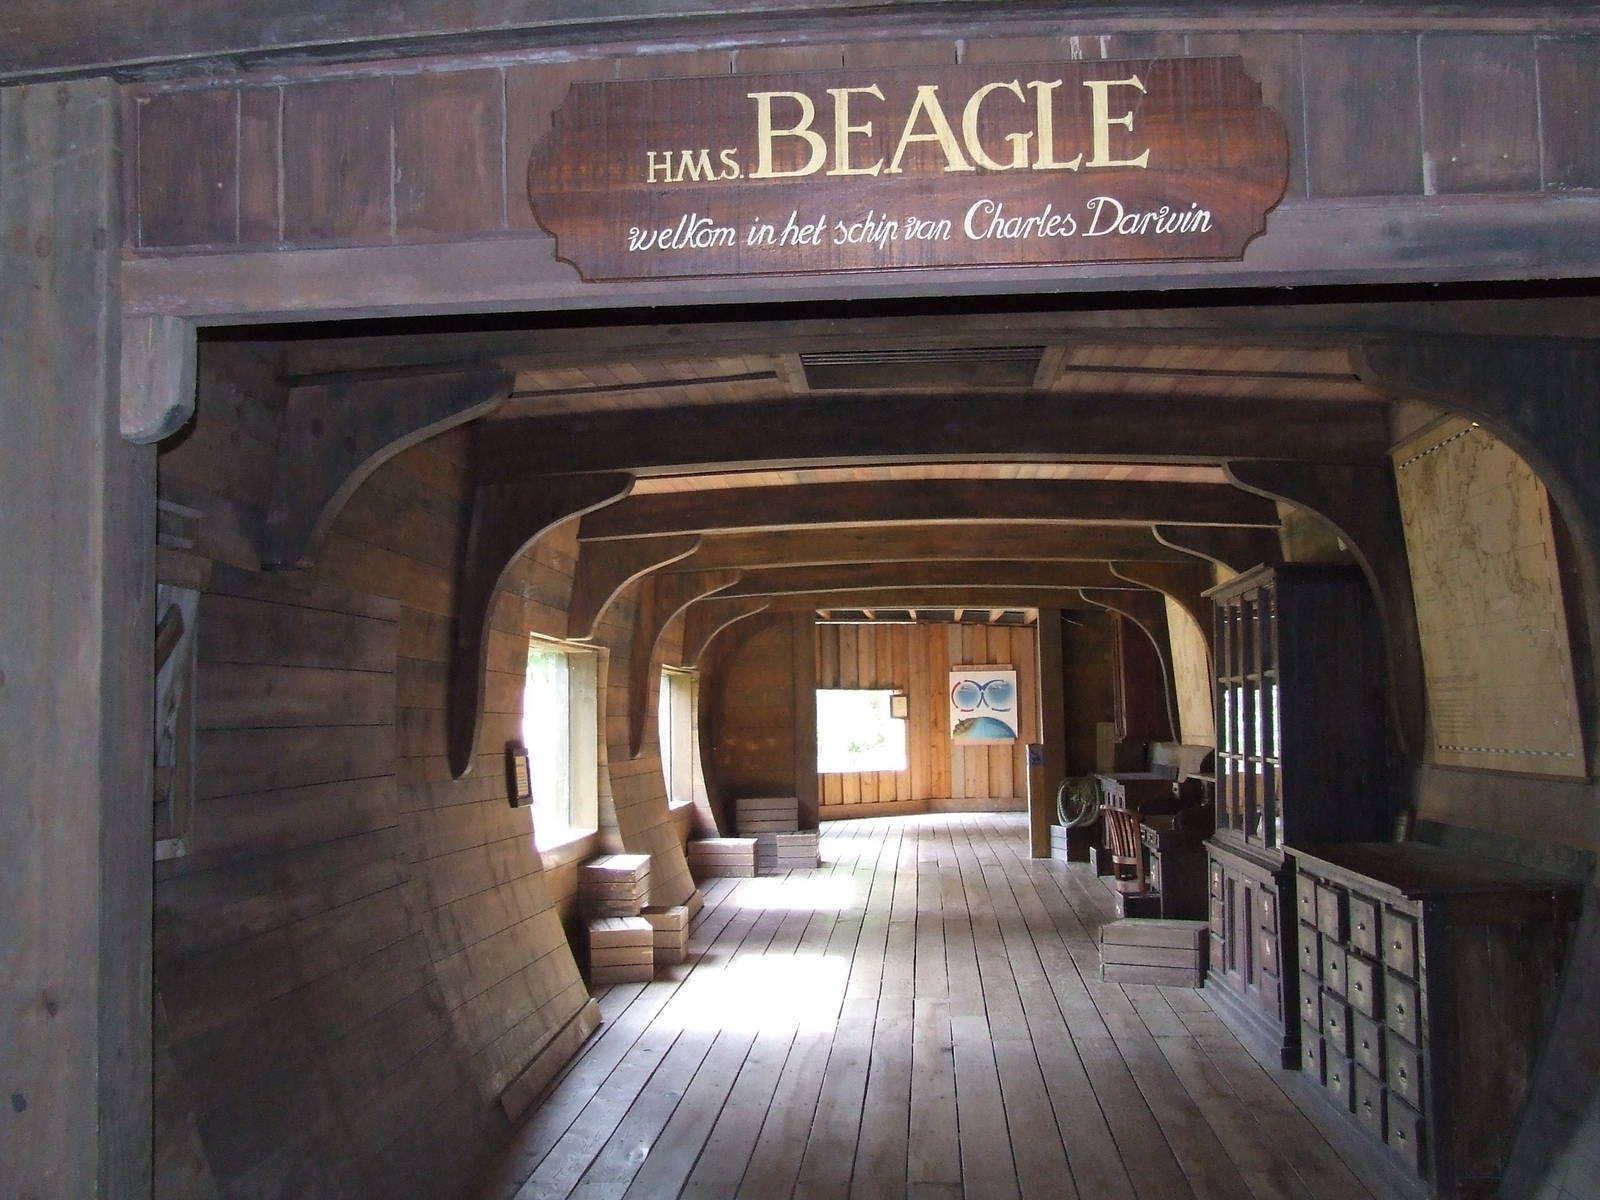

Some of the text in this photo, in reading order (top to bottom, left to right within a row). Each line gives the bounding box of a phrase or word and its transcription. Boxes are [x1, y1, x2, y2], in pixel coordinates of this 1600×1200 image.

[747, 74, 1151, 179] BEAGLE
[628, 196, 1213, 251] welkom in het schip van Charles Darwin
